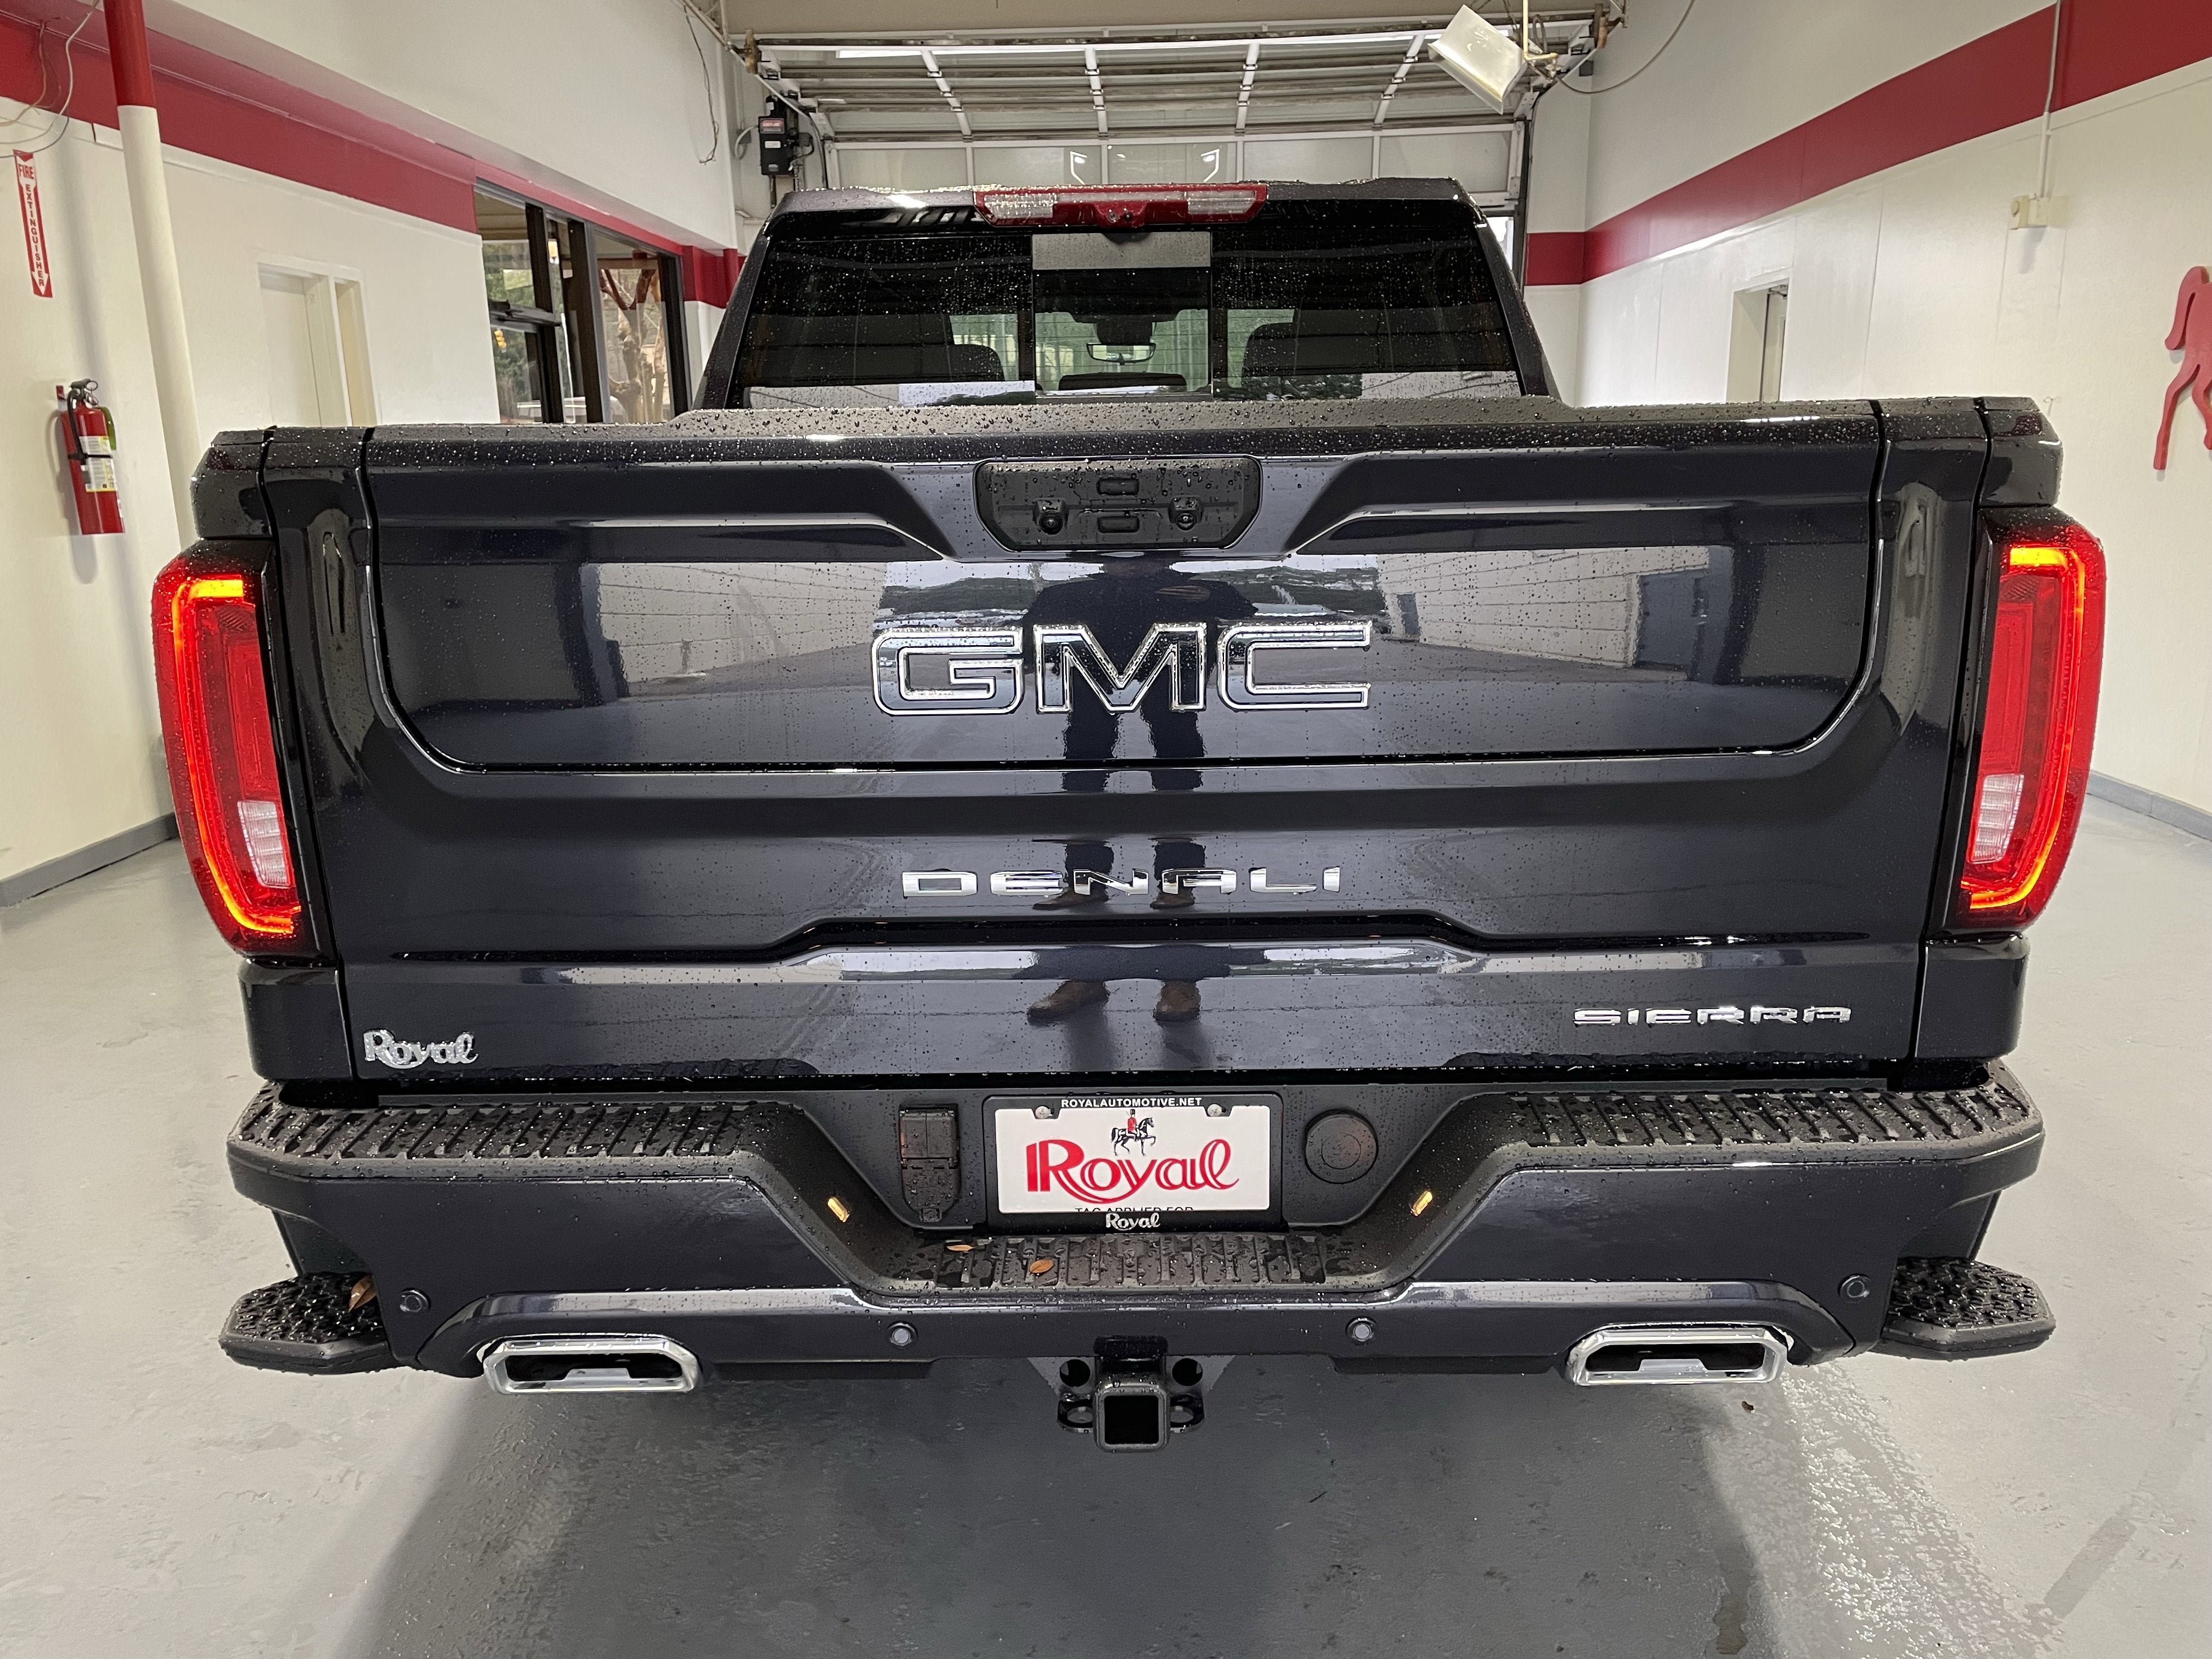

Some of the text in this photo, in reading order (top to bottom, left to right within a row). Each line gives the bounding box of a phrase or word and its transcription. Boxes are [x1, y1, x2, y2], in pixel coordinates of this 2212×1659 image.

[19, 164, 34, 179] FIRE
[25, 184, 44, 286] EXTINGUISHER
[872, 621, 1373, 715] GMC
[902, 867, 1340, 896] DENALI
[1573, 1006, 1852, 1025] SIERRA
[363, 1030, 479, 1069] Royal
[1061, 1098, 1202, 1108] ROYALAUTOMOTIVE.NET
[1026, 1139, 1240, 1204] Royal
[1105, 1212, 1161, 1231] Royal
